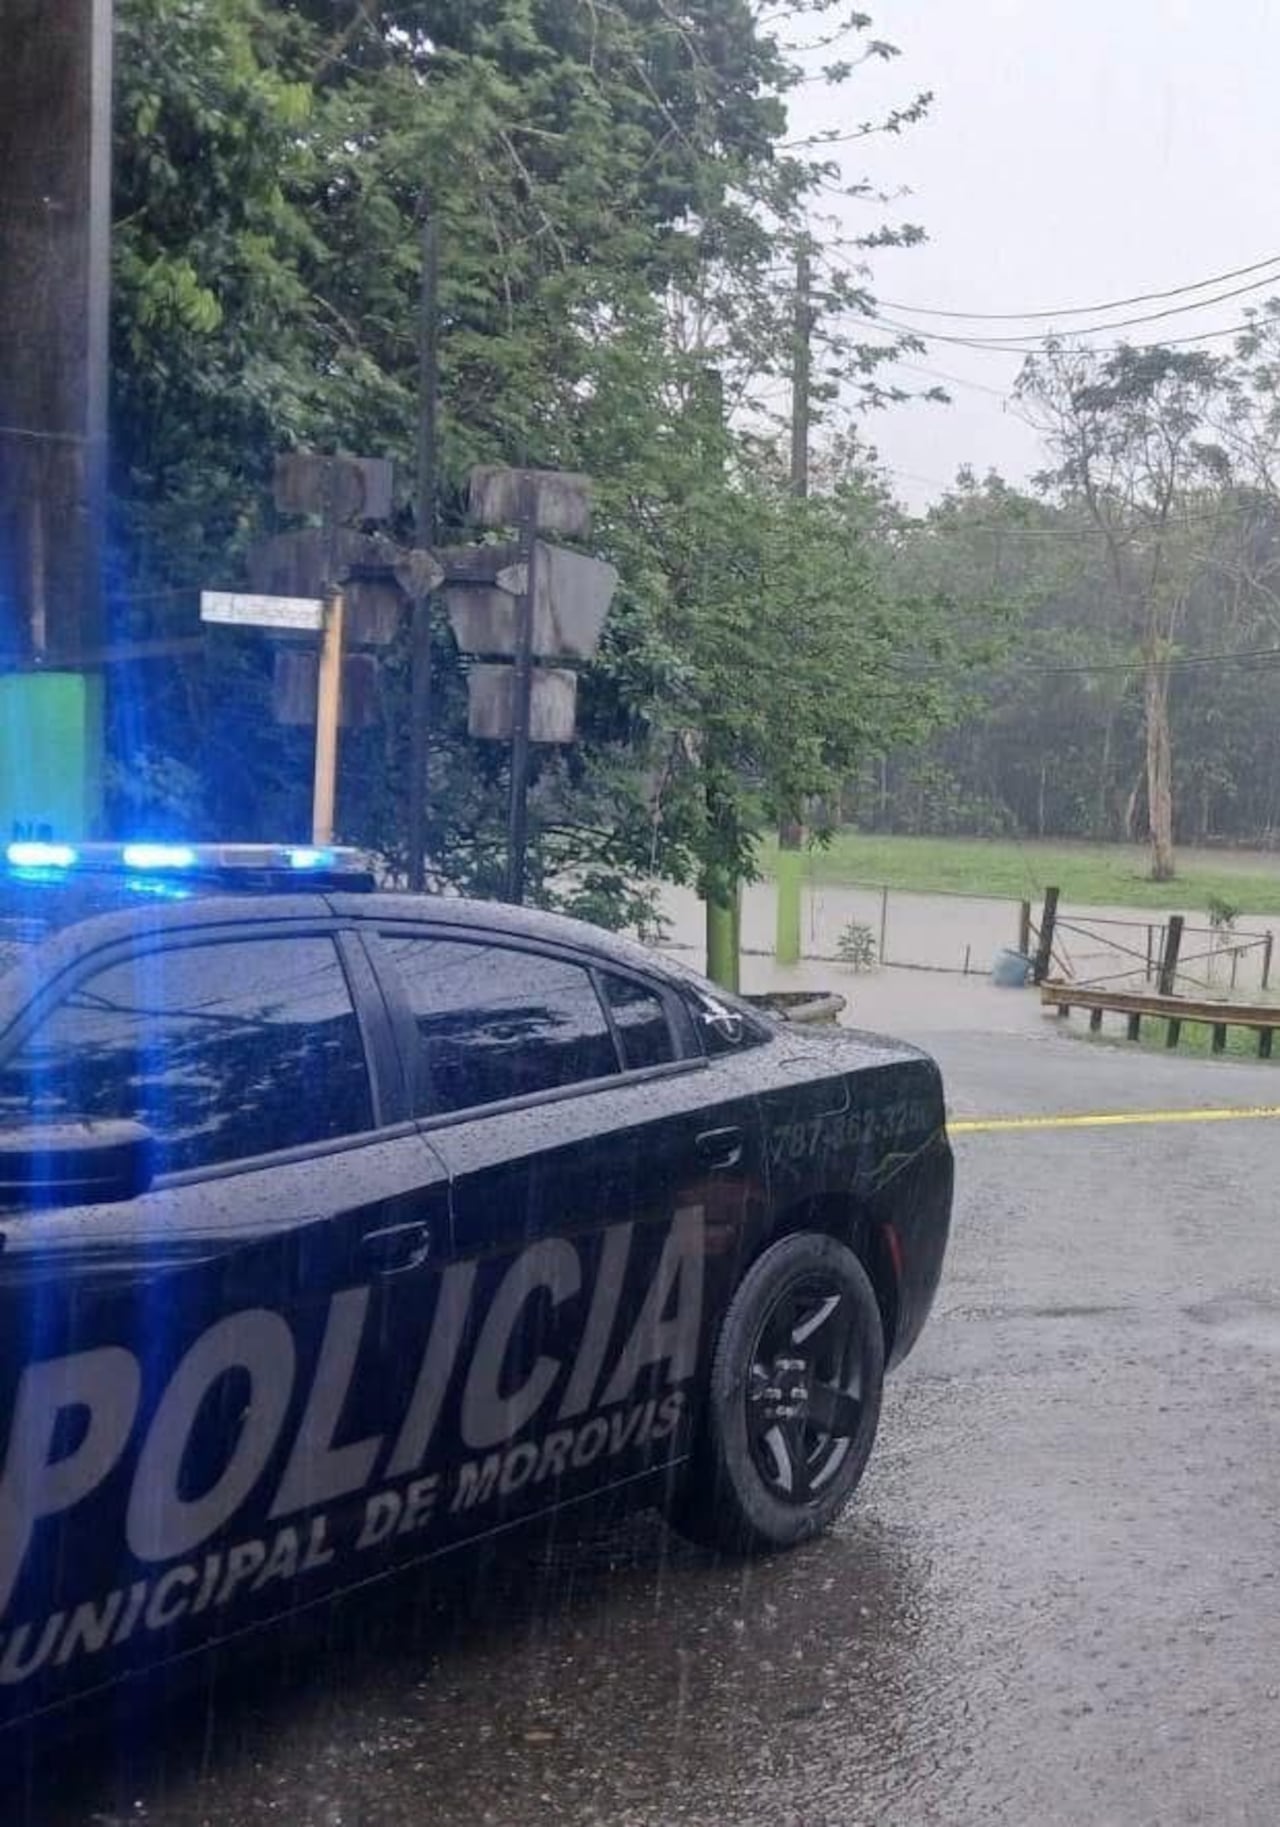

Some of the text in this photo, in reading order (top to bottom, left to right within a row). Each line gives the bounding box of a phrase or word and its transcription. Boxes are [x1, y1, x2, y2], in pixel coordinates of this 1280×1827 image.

[0, 1205, 706, 1618] POLICIA
[0, 1391, 686, 1685] UNICIPAL DE MOROVIS
